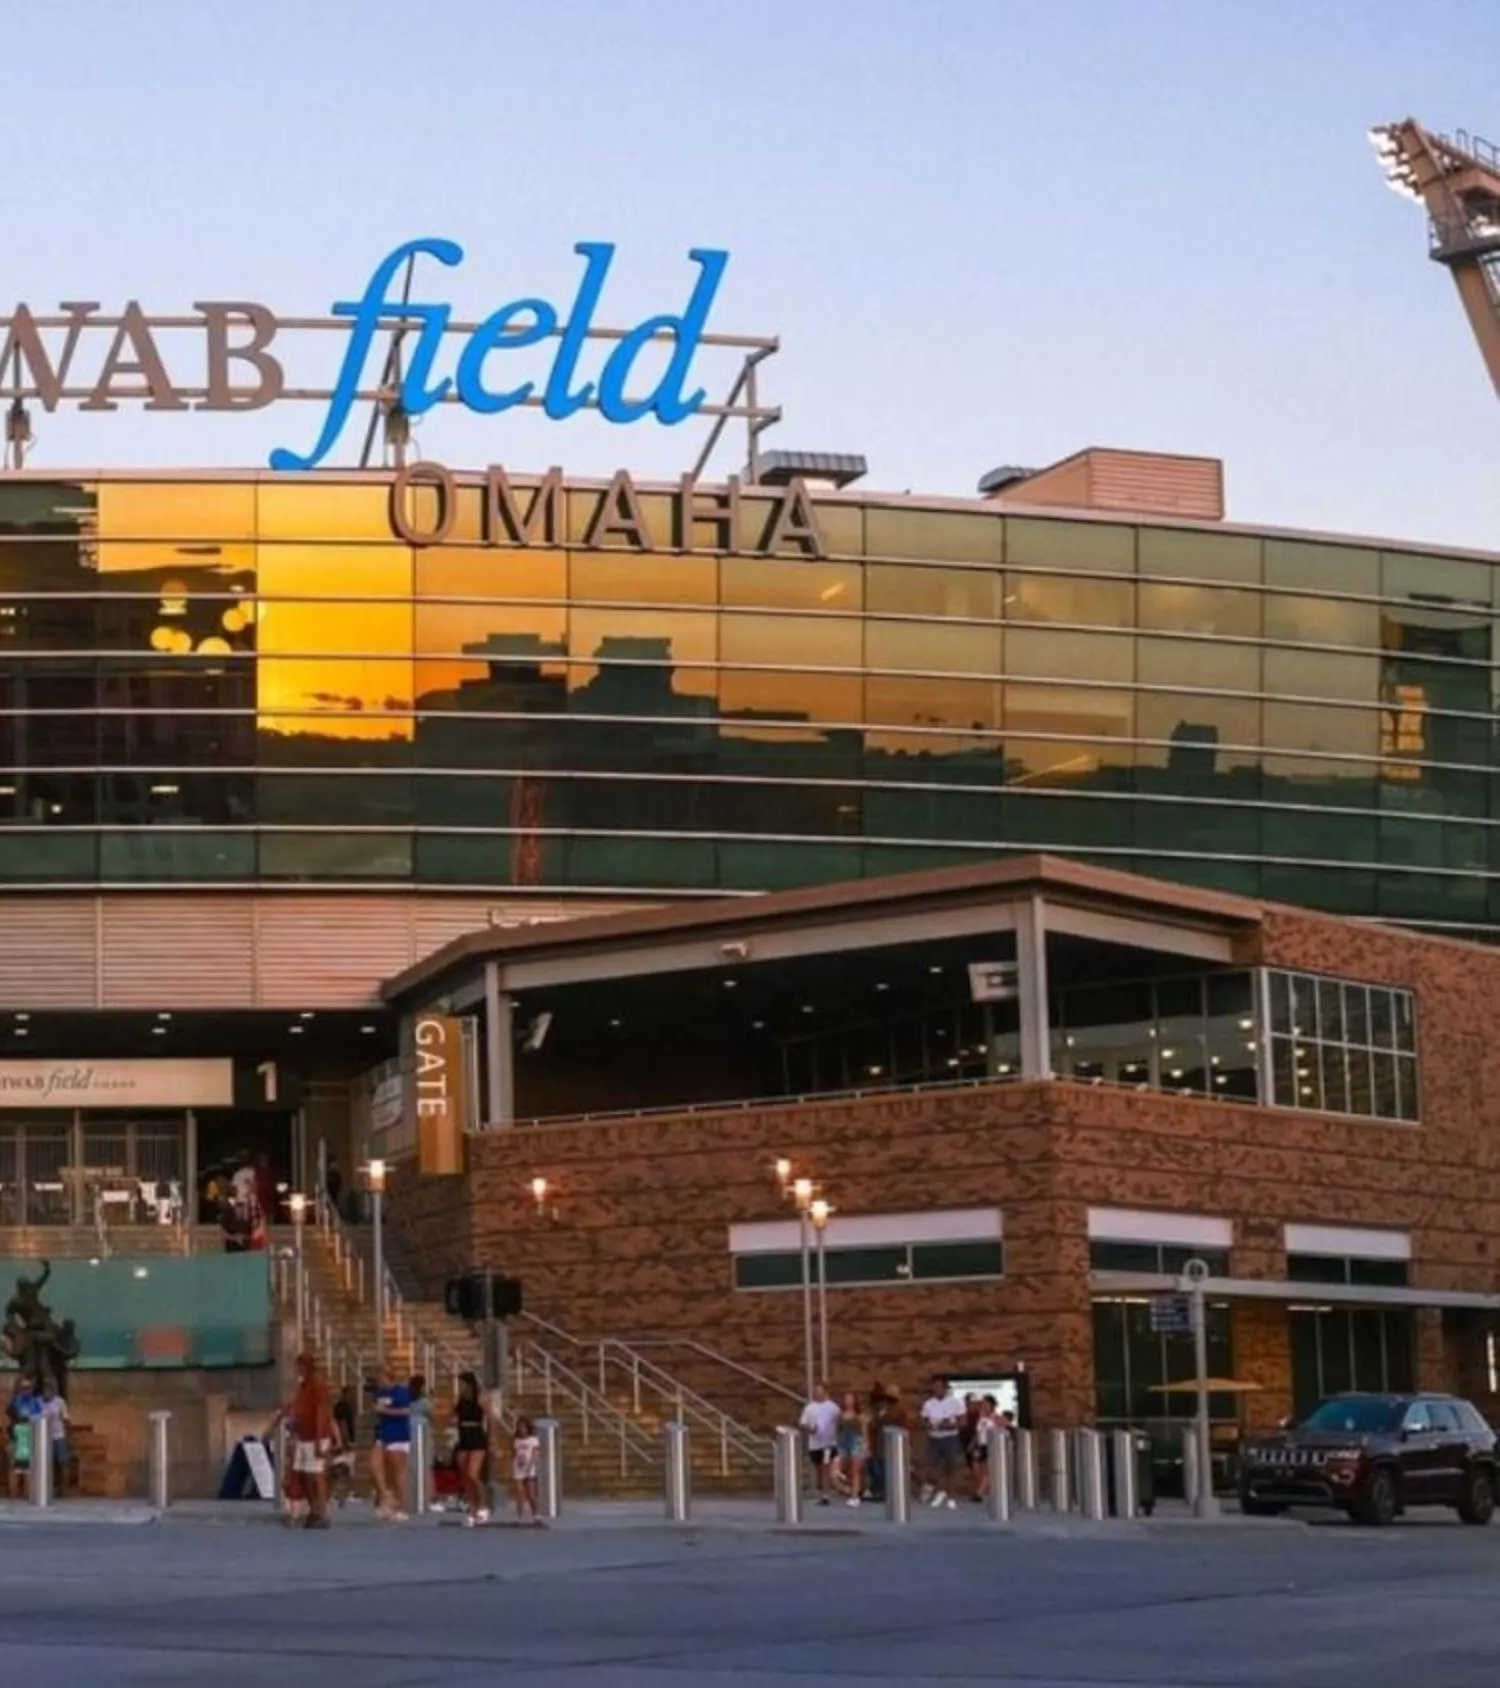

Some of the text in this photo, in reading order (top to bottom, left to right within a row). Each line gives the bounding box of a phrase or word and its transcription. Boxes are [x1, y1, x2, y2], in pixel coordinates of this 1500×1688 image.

[268, 238, 730, 470] field
[387, 461, 828, 560] OMAHA
[256, 1061, 278, 1102] 1
[414, 1019, 447, 1118] GATE
